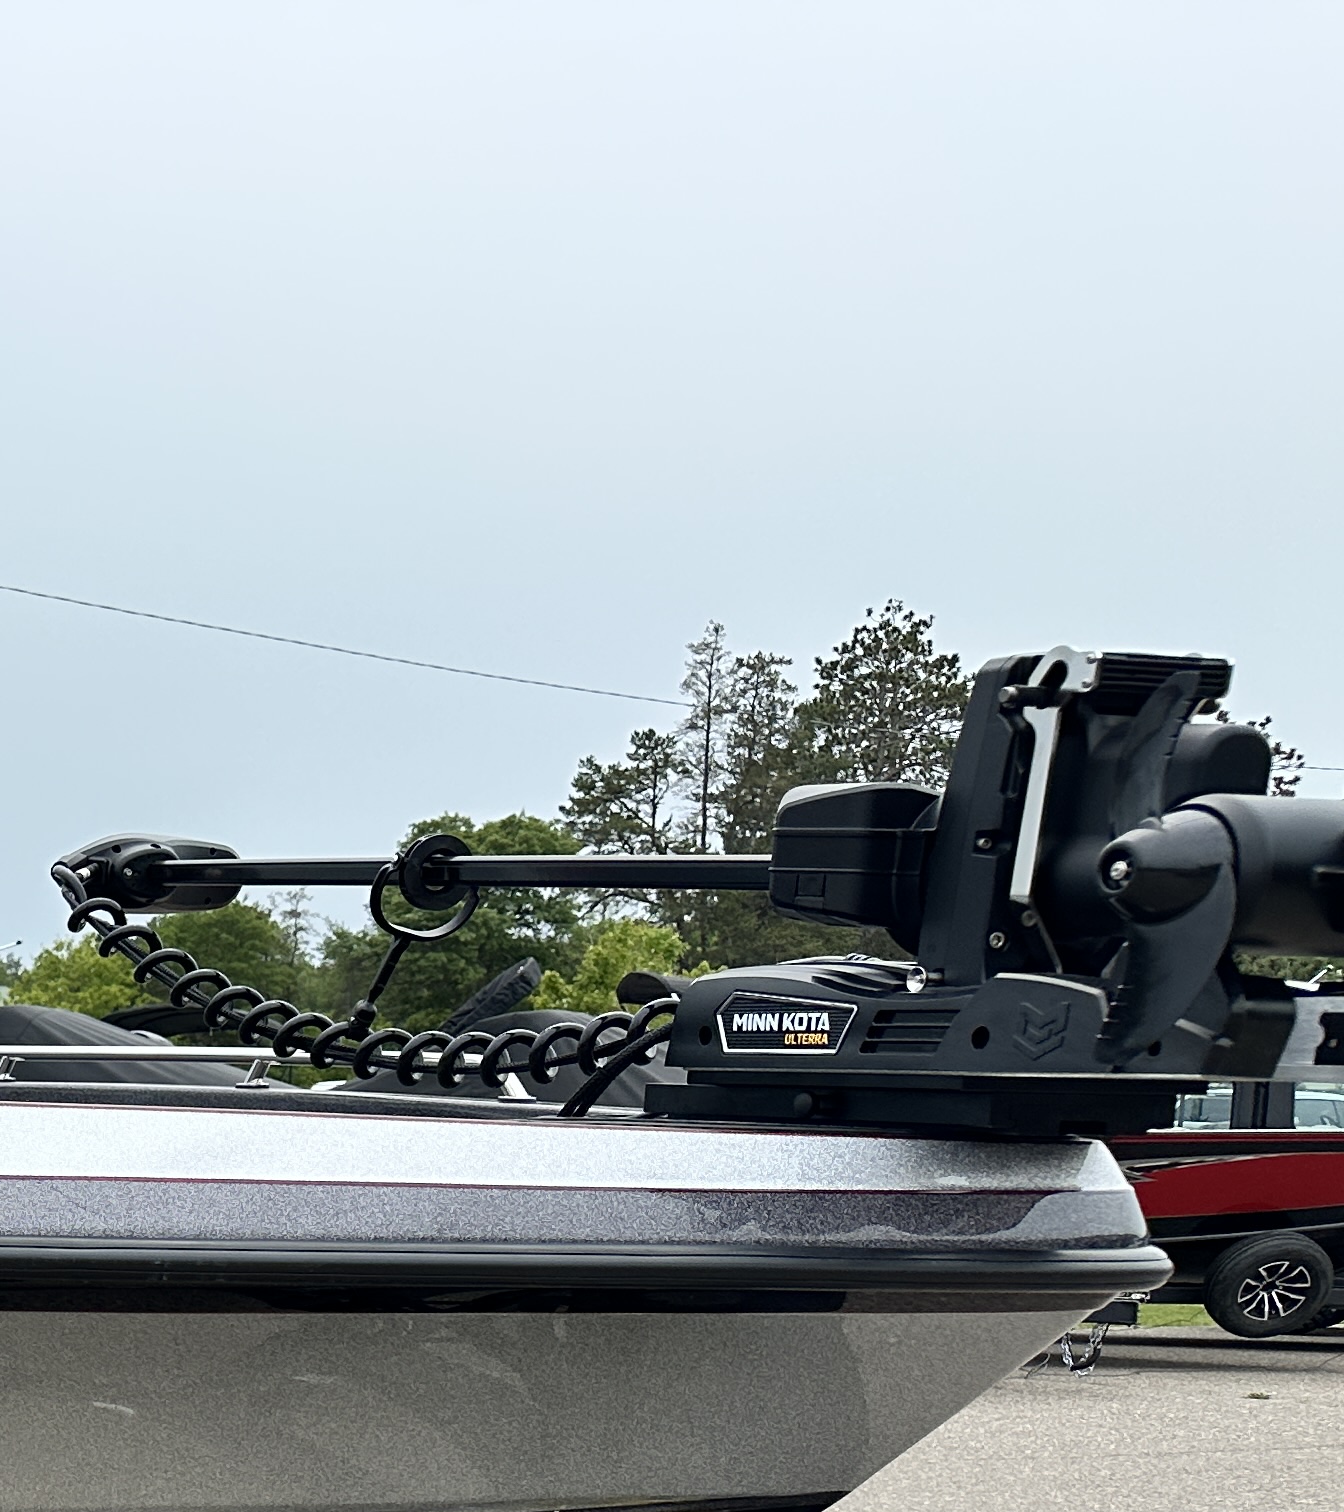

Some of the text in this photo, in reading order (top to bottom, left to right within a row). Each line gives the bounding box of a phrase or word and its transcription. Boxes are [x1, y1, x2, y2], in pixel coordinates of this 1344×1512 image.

[732, 1012, 830, 1032] MINN KOTA
[784, 1033, 829, 1045] ULTERRA
